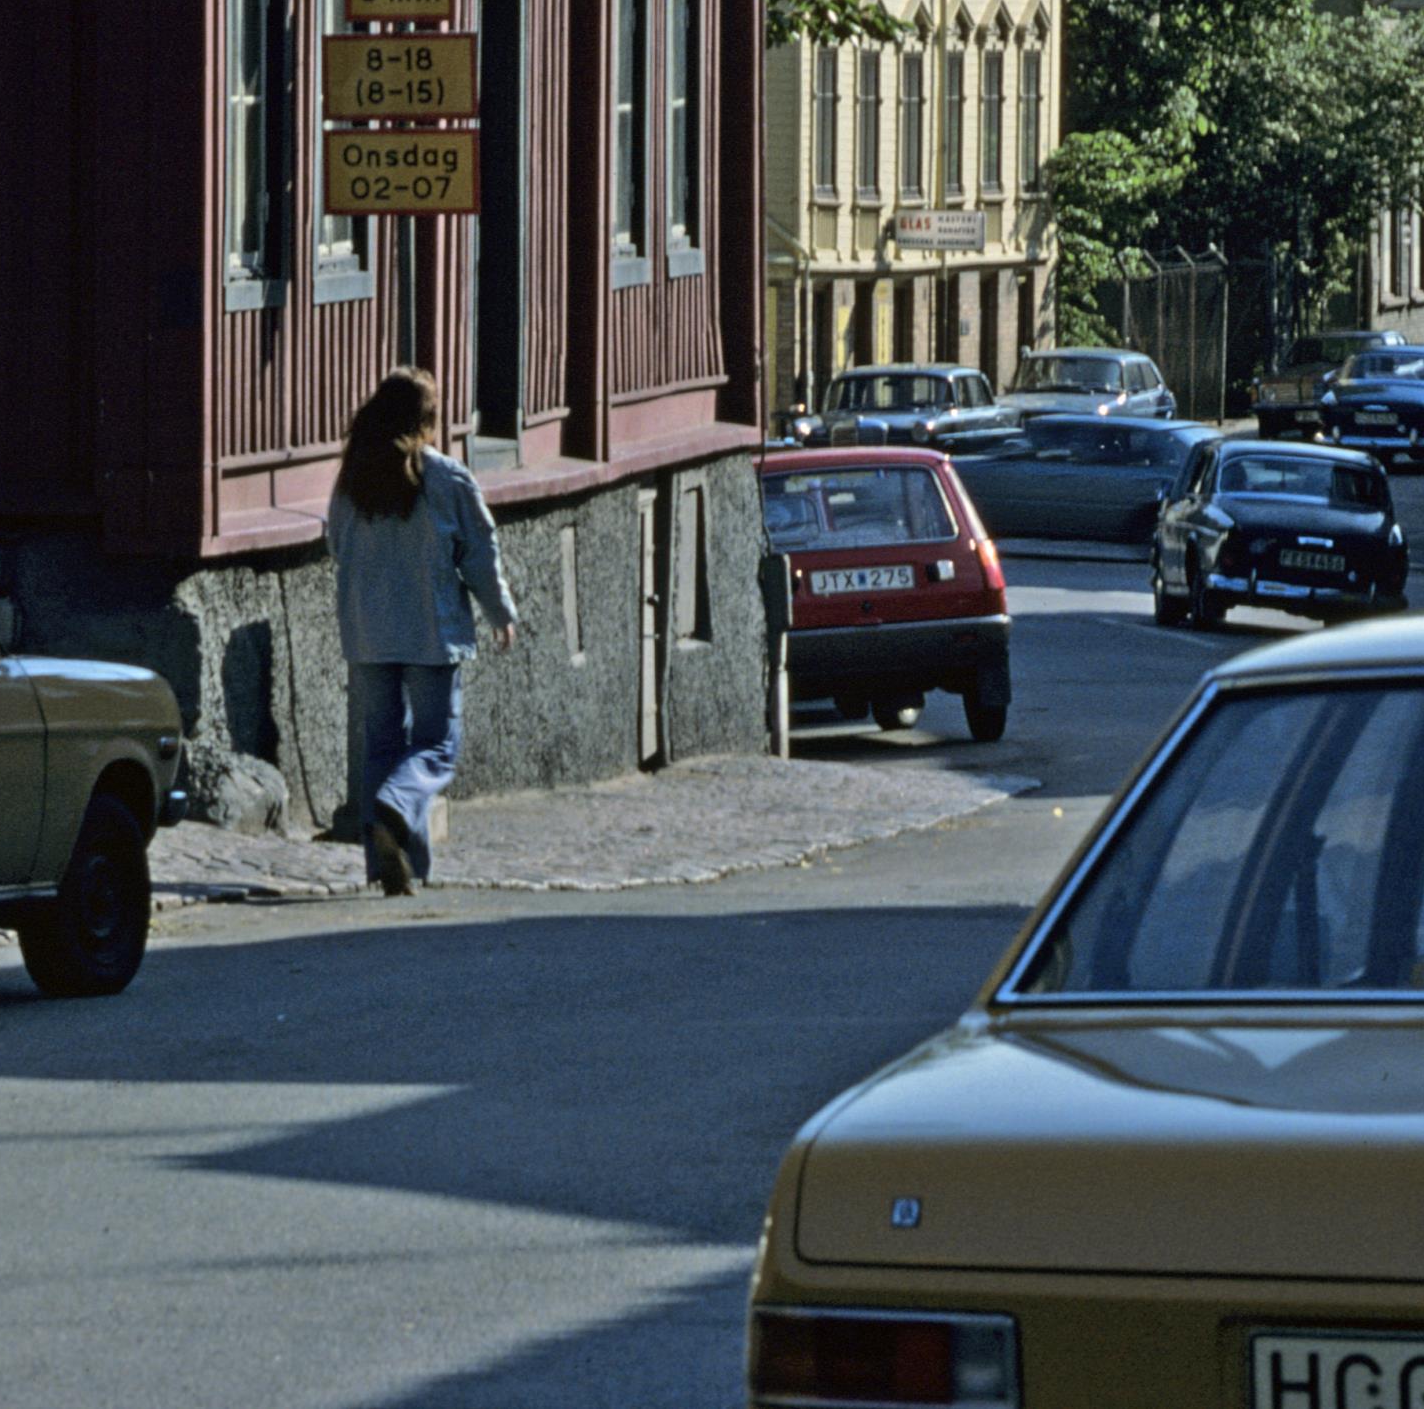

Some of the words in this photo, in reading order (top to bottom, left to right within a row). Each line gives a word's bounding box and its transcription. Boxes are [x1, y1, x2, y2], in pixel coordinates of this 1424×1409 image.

[366, 47, 433, 71] 8-18
[356, 78, 445, 107] (8-15)
[342, 143, 459, 173] Onsdag
[350, 176, 452, 201] 02-07
[900, 216, 930, 230] GLAS
[818, 571, 855, 591] JTX
[870, 568, 910, 586] 275
